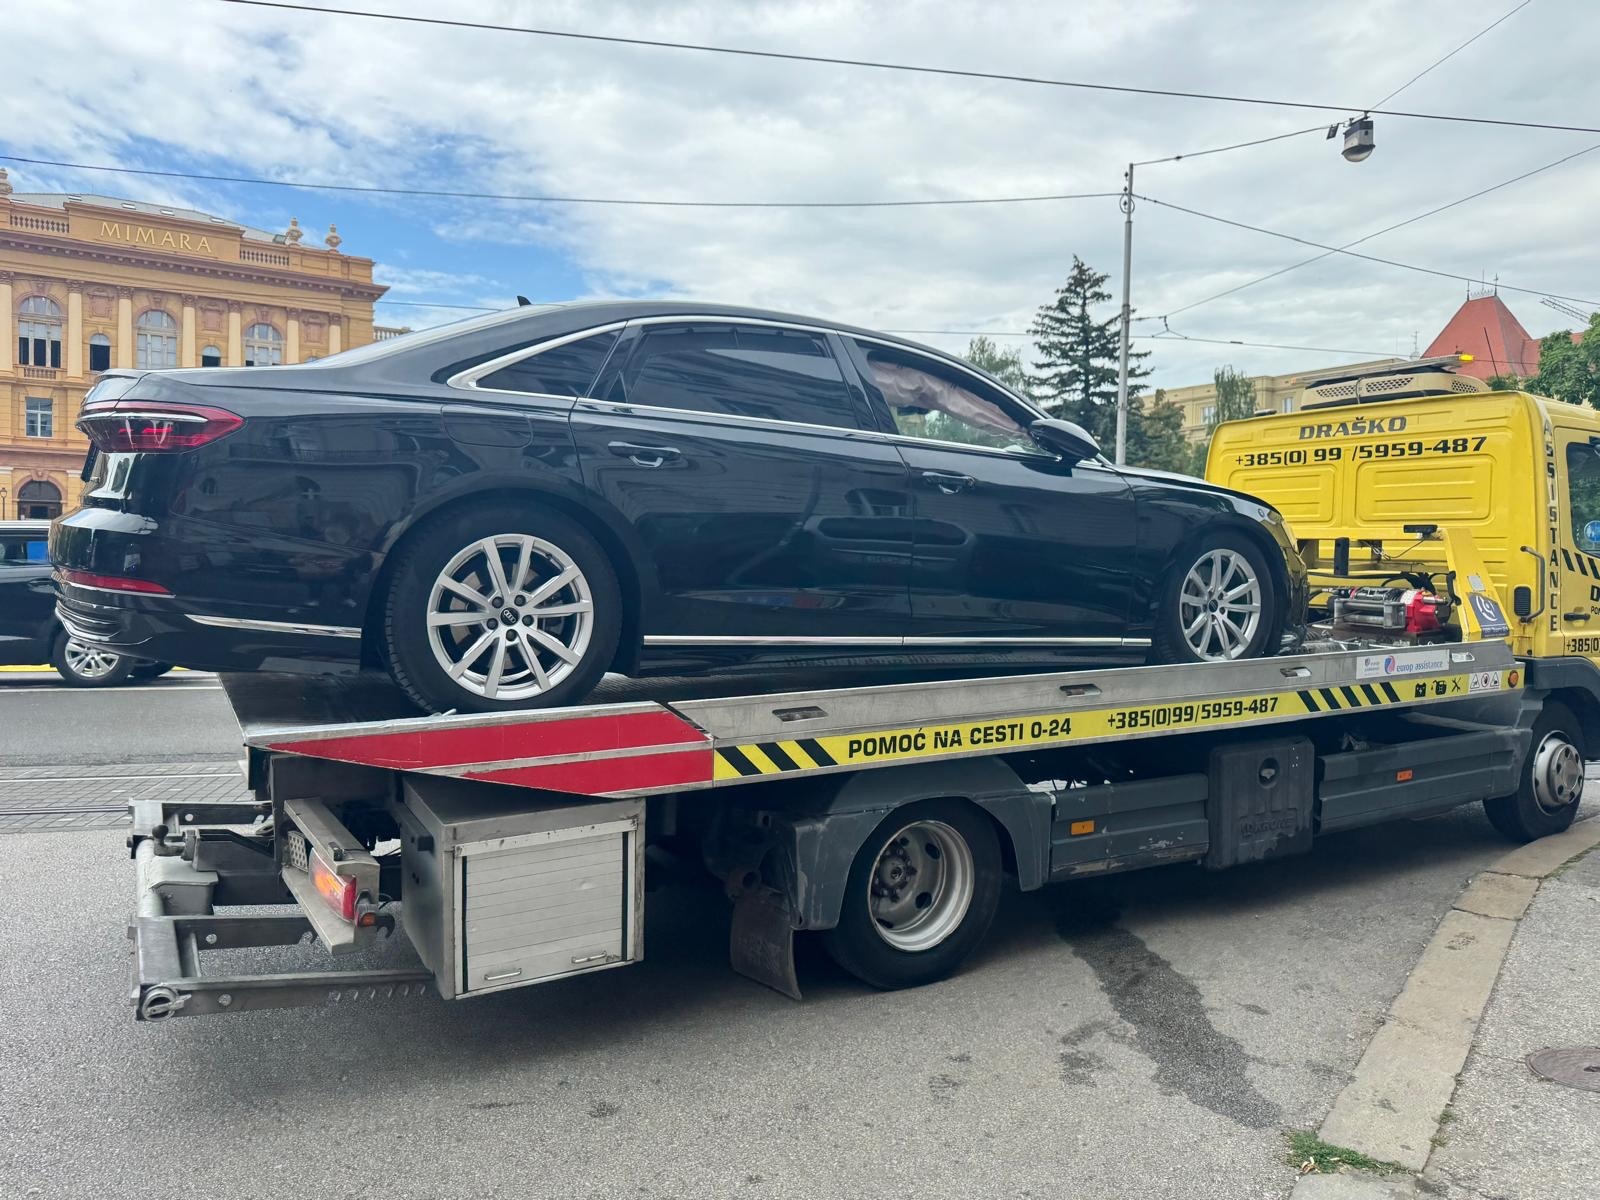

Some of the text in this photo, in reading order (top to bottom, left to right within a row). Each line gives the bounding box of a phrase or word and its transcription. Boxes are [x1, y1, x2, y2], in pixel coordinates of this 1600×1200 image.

[100, 221, 212, 253] MIMARA
[1299, 416, 1407, 440] DRAŠKO
[1236, 436, 1487, 467] +385(0) 99 /5959-487
[1544, 418, 1559, 631] ASSISTANCE
[1396, 660, 1443, 673] europ assistance
[1107, 697, 1279, 729] +385(0)99/5959-487
[848, 717, 1072, 759] POMOĆ NA CESTI 0-24
